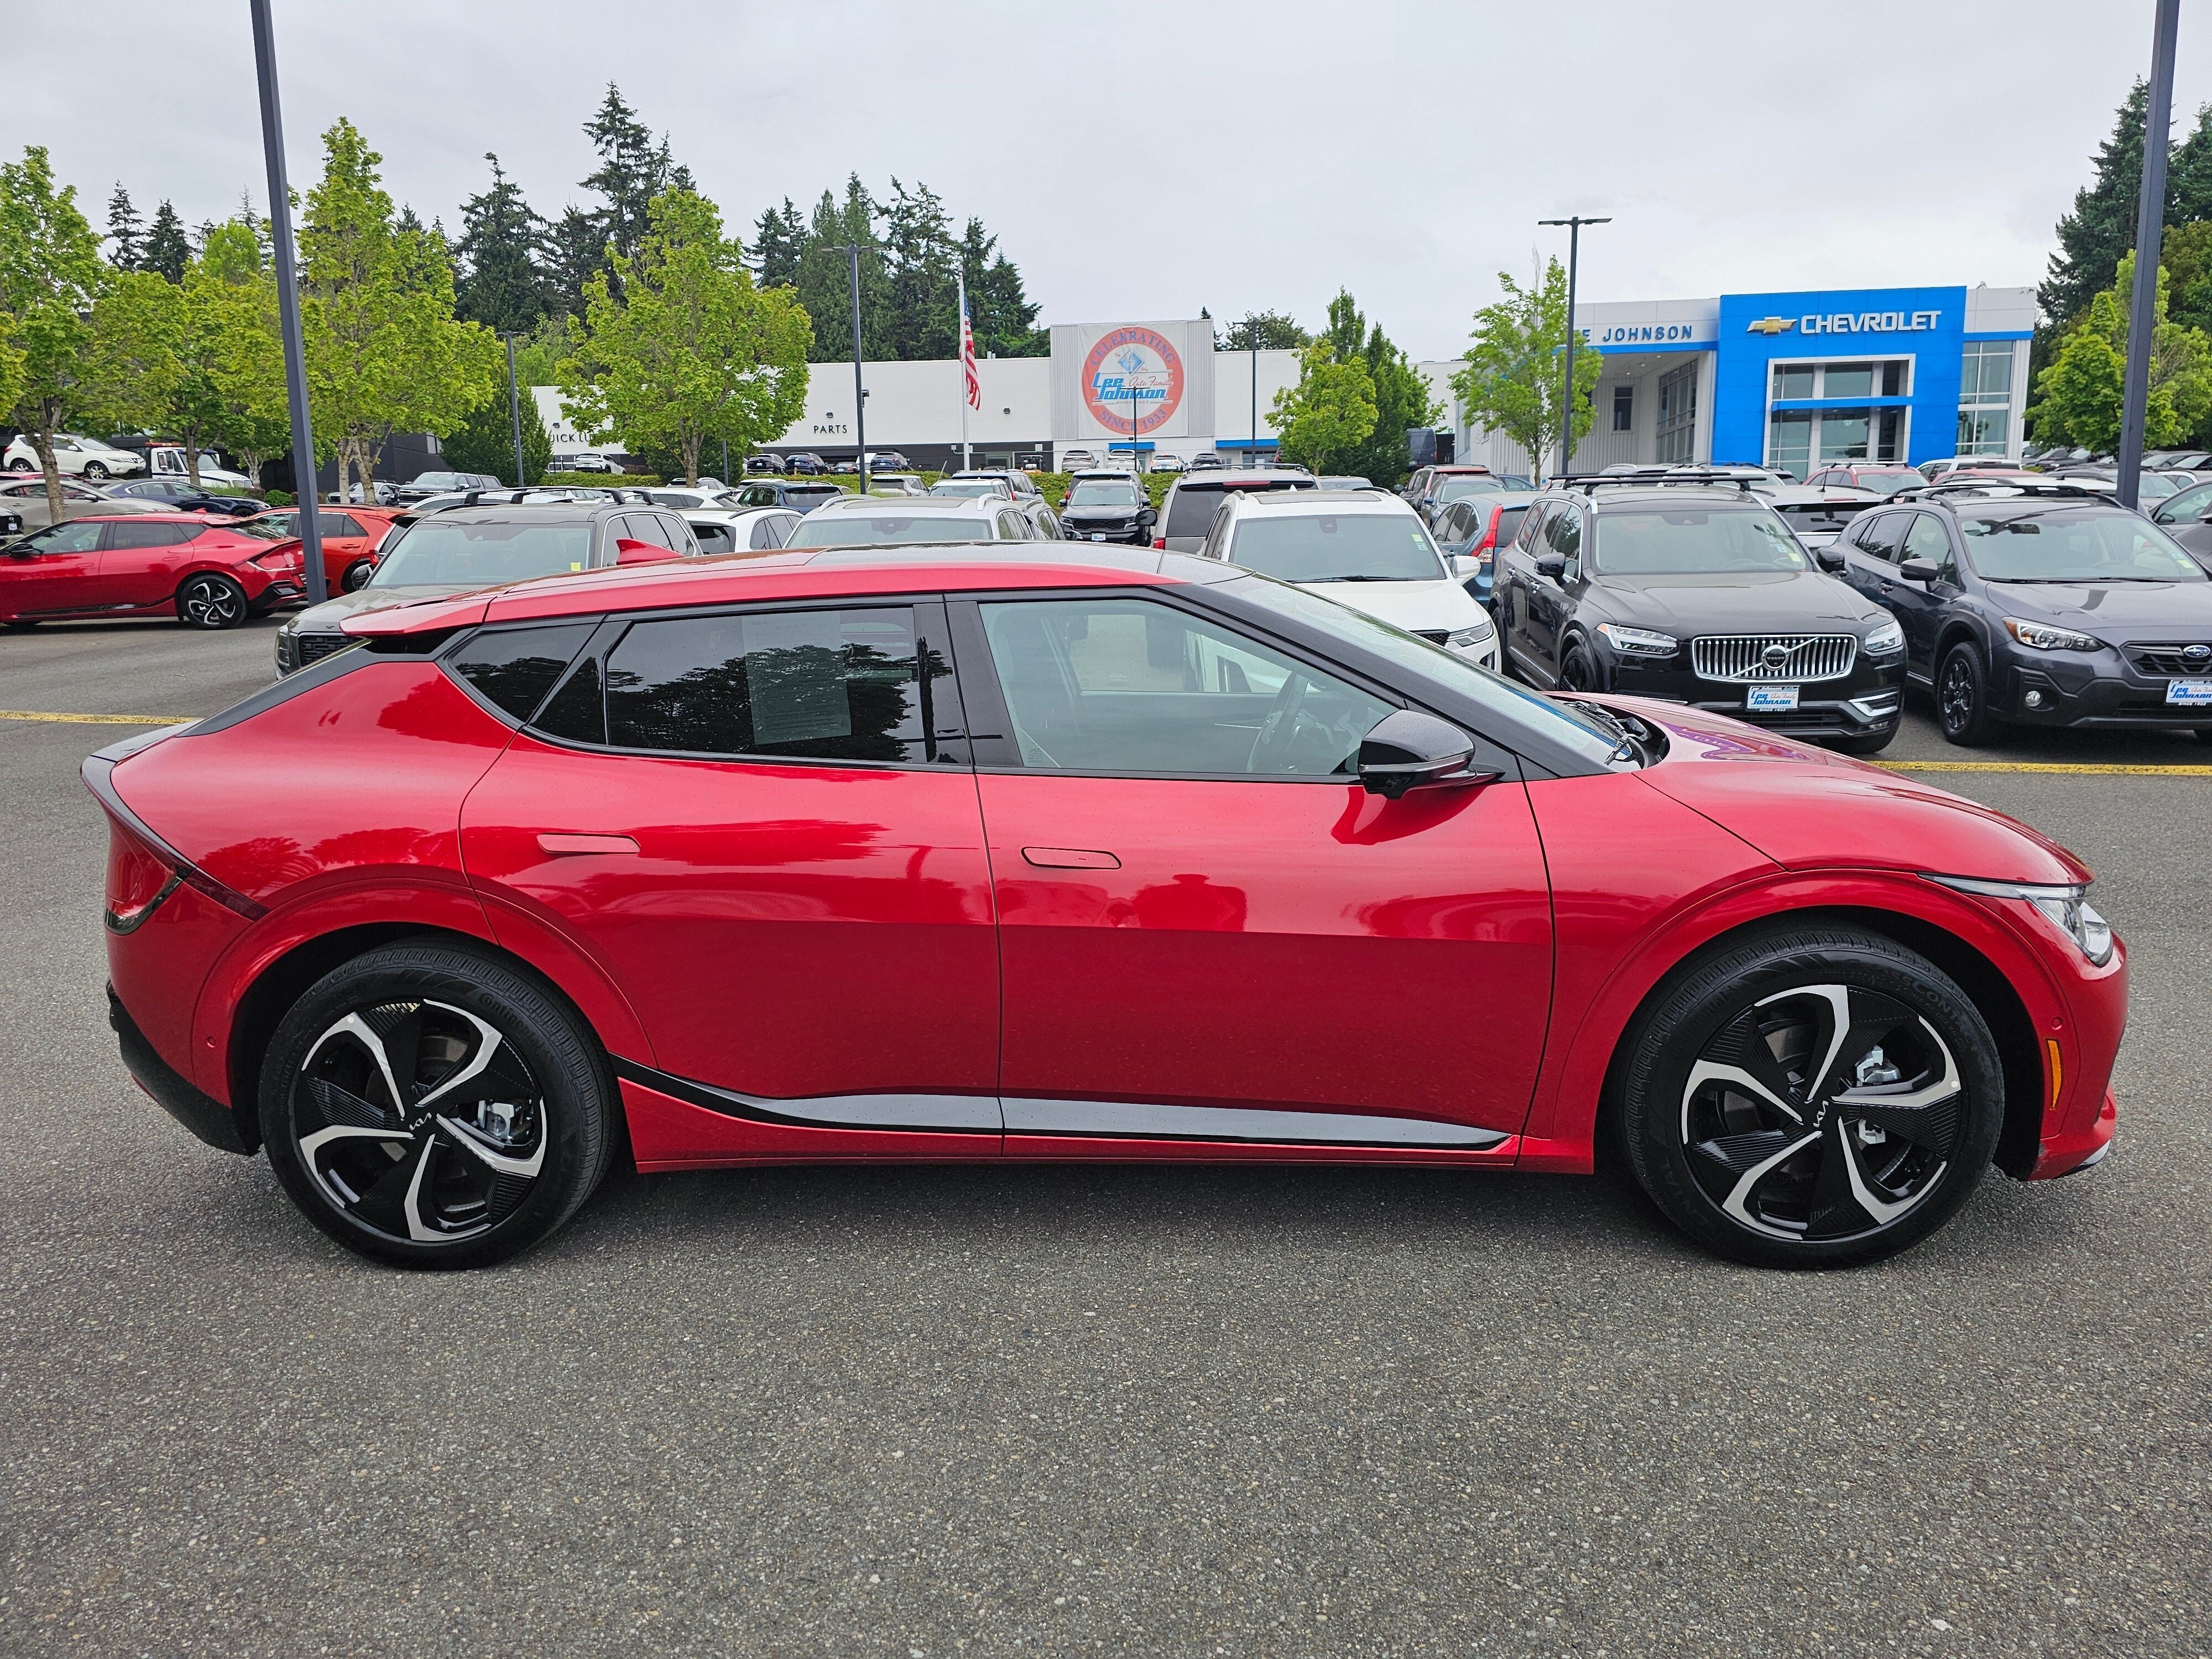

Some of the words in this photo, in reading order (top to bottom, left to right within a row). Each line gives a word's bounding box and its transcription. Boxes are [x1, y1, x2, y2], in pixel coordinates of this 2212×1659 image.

[1801, 310, 1942, 335] CHEVROLET
[1603, 325, 1692, 342] JOHNSON
[1090, 331, 1175, 366] CELEBRATING
[1092, 372, 1125, 388] Lee
[1129, 376, 1147, 387] Auto
[1148, 375, 1173, 389] Family
[1094, 385, 1168, 400] Johnson
[1099, 410, 1138, 431] SINCE
[1142, 409, 1166, 430] 1933
[813, 424, 847, 434] PARTS
[550, 434, 576, 442] UICK
[1750, 690, 1768, 698] Lee
[2170, 684, 2189, 692] Lee
[409, 1112, 432, 1131] KIA
[1812, 1100, 1829, 1128] KIA
